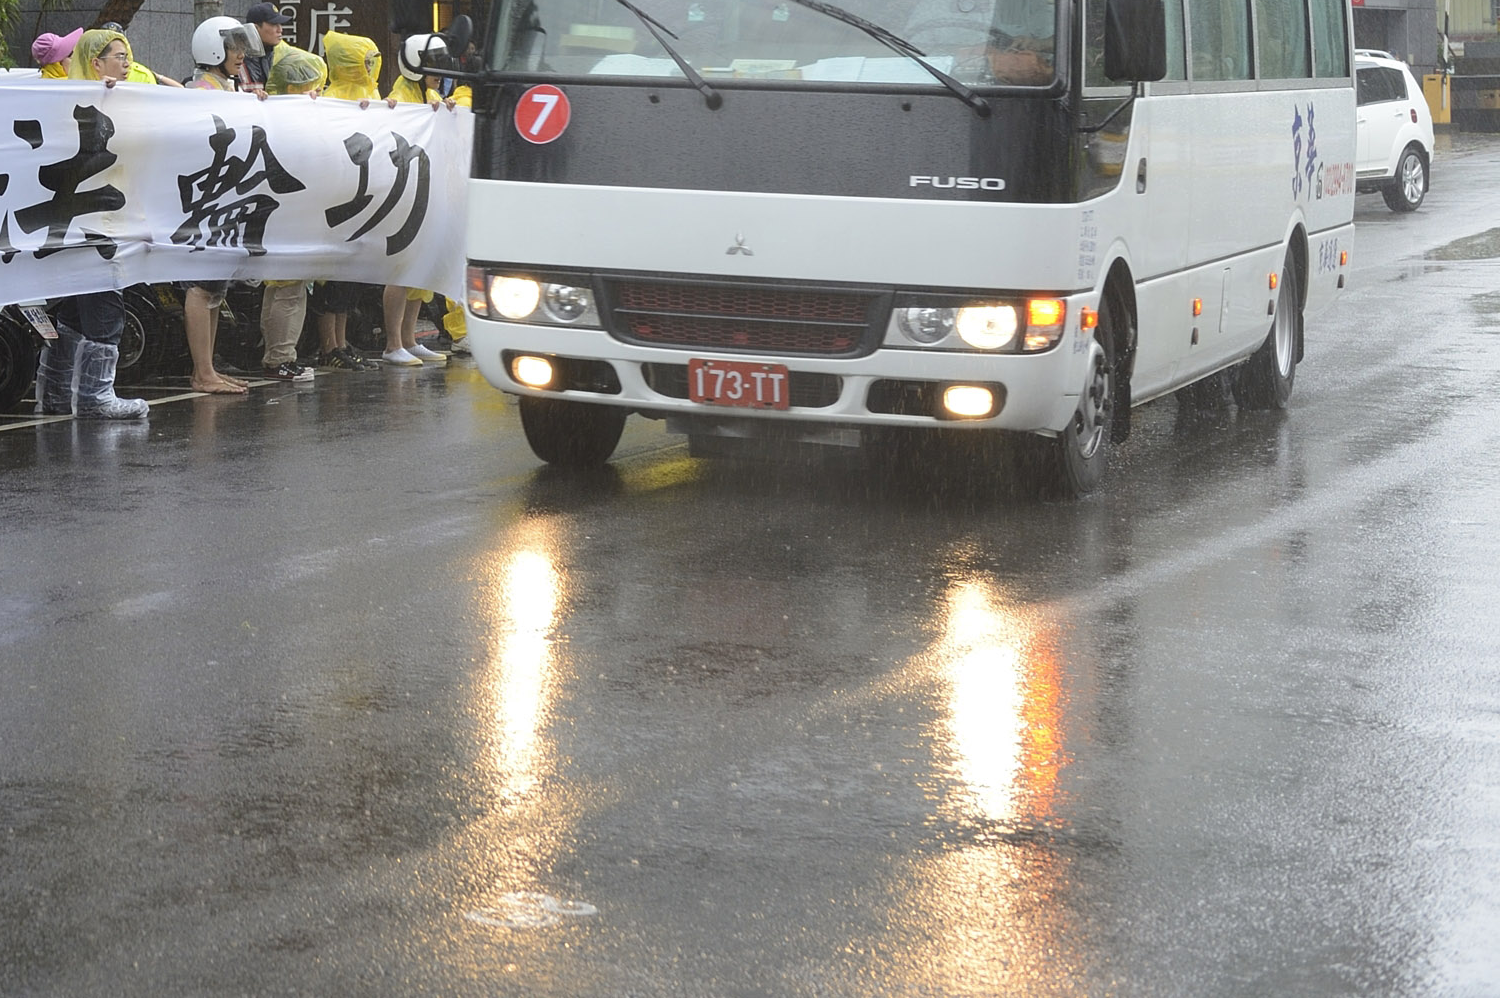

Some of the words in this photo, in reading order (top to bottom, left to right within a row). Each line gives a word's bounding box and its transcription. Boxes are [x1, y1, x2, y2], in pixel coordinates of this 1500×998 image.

[529, 93, 559, 135] 7
[909, 175, 1006, 190] FUSO
[695, 368, 785, 402] 173-TT
